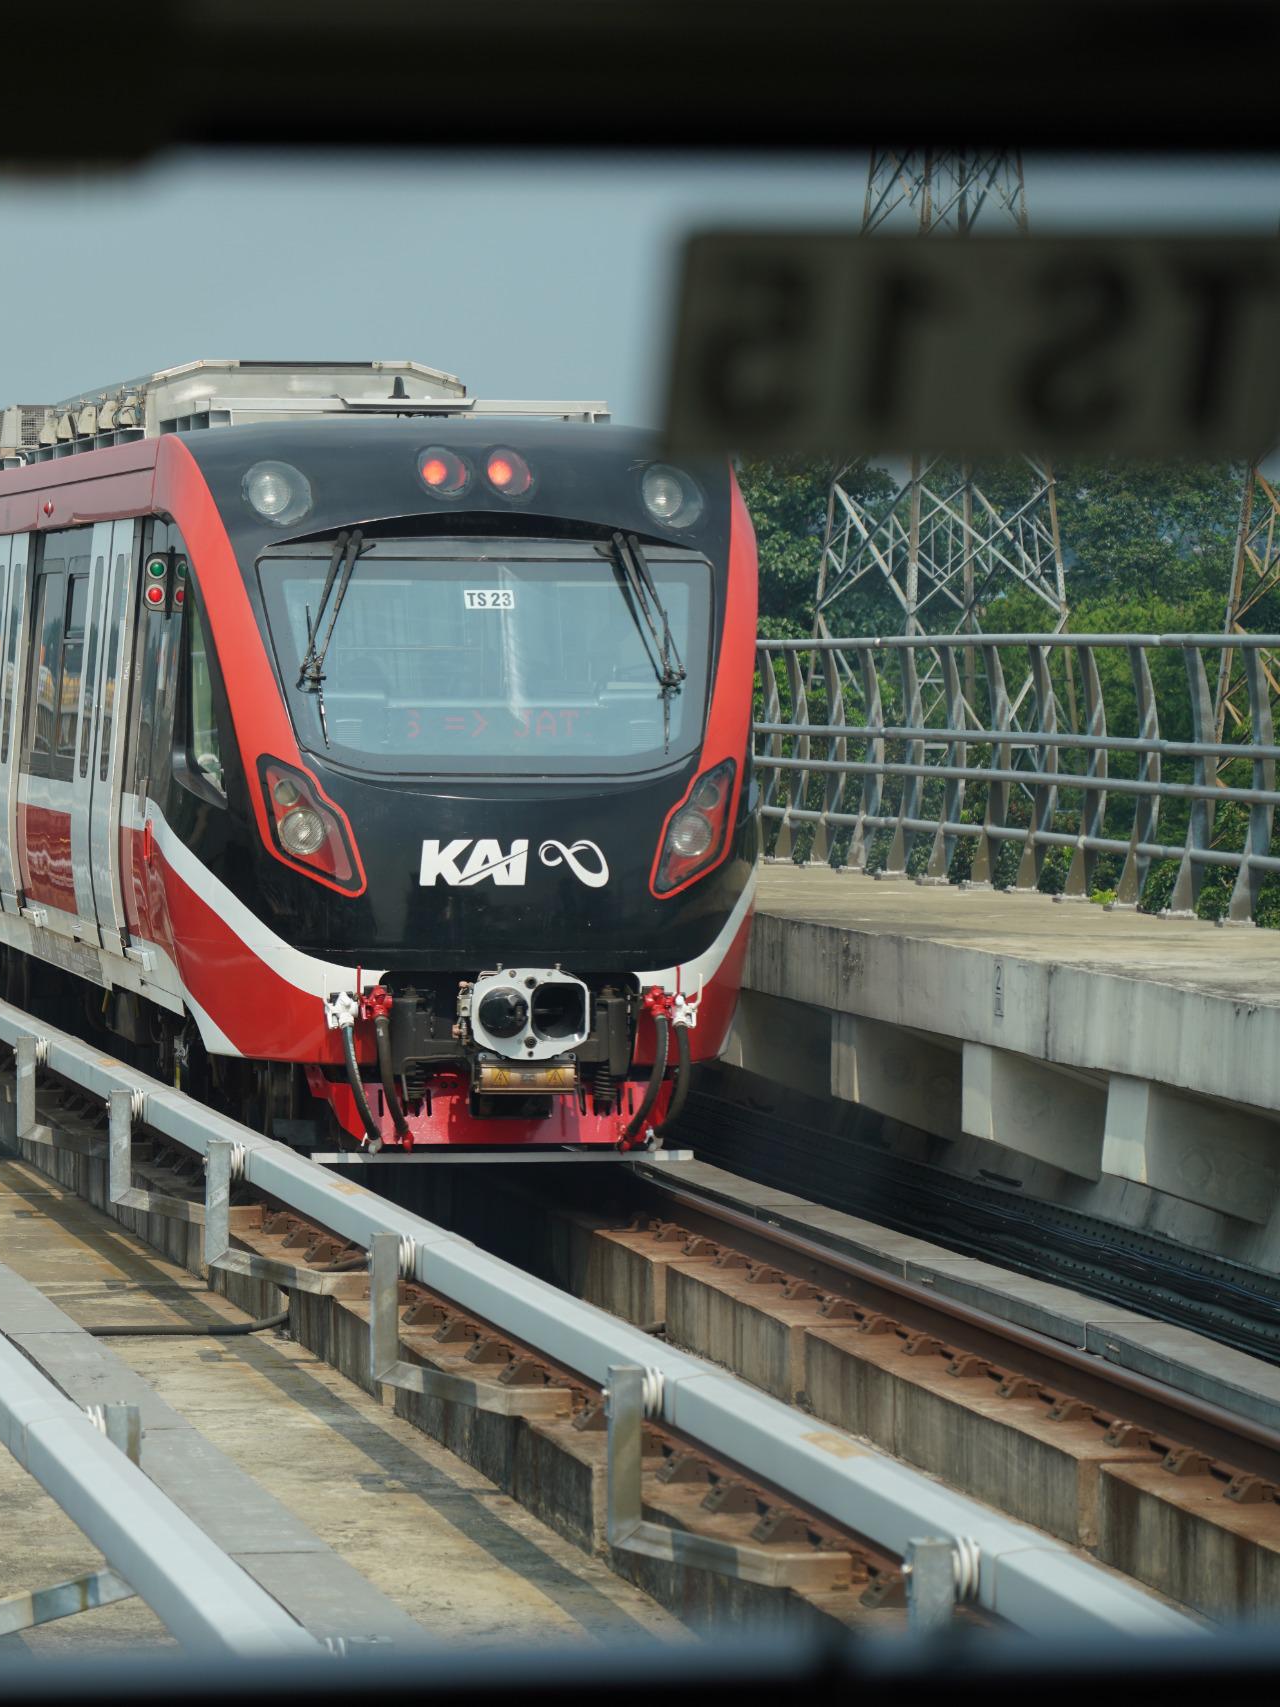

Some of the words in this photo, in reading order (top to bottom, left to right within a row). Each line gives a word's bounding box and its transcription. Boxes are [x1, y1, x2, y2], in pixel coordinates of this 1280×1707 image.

[467, 592, 487, 607] TS
[491, 592, 512, 607] 23
[419, 838, 529, 887] KAI
